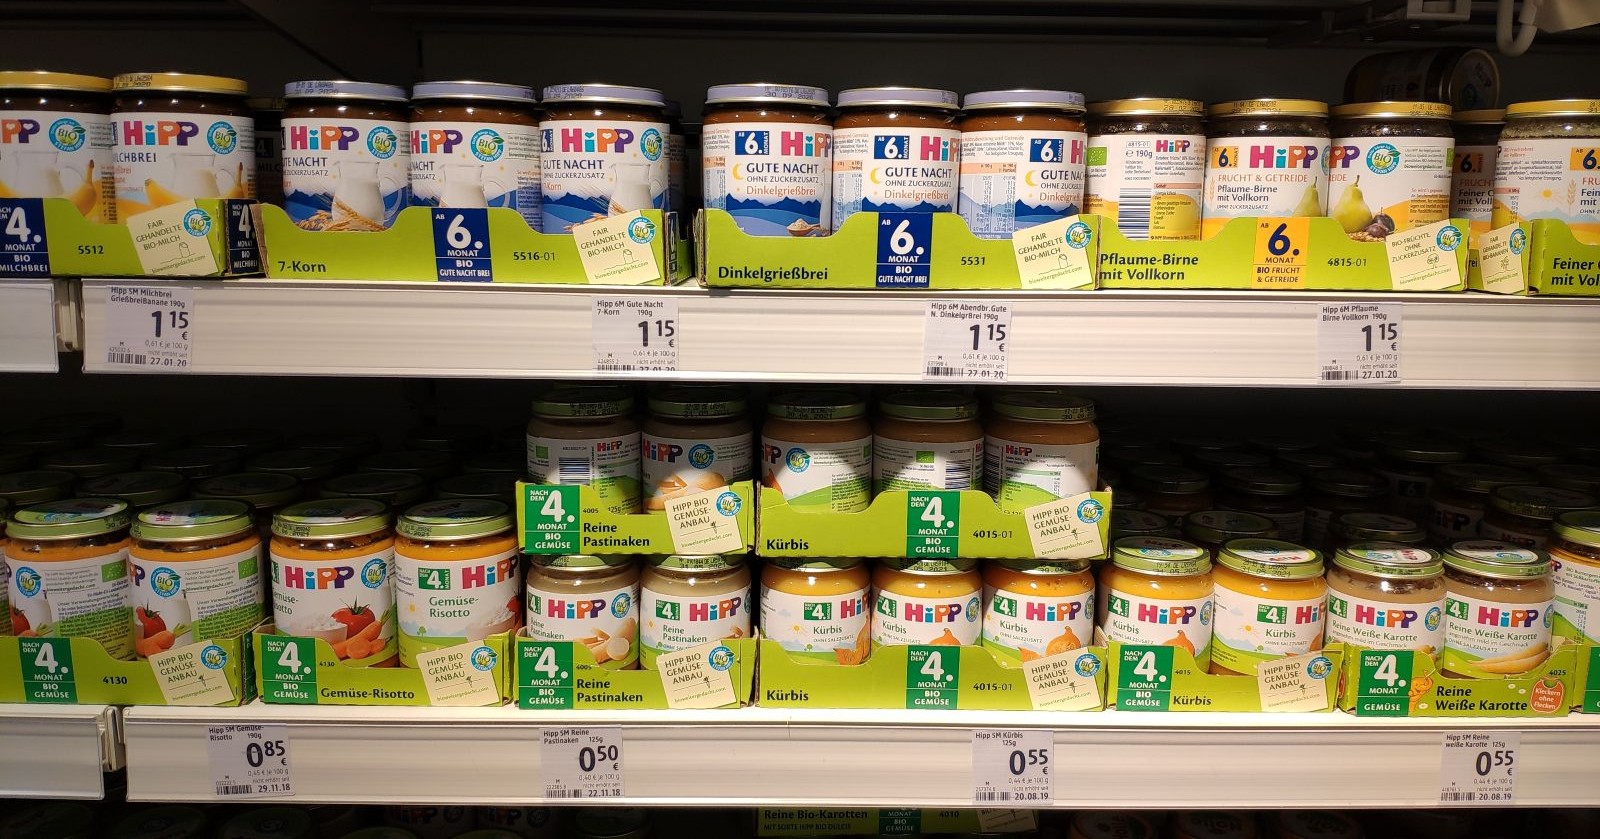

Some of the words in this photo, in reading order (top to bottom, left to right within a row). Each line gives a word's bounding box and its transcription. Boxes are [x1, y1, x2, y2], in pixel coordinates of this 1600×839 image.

[291, 126, 359, 150] HiPP
[561, 128, 634, 153] HiPP
[1156, 140, 1190, 153] HiPP
[1249, 145, 1318, 169] HiPP
[746, 163, 779, 173] GUTE
[783, 164, 819, 173] NACHT
[1265, 174, 1308, 183] GETREIDE
[746, 186, 816, 197] Dinkelgrießbrei
[5, 207, 41, 243] 4.
[446, 214, 484, 250] 6.
[592, 228, 608, 236] FAIR
[890, 219, 924, 255] 6.
[580, 232, 626, 250] GEHANDELTE
[1268, 224, 1300, 256] 6.
[1392, 232, 1431, 247] BIO-FRÜCHTE
[78, 245, 104, 255] 5512
[587, 242, 625, 258] BIO-MILCH
[1404, 242, 1422, 251] OHNE
[14, 255, 31, 263] BIO
[447, 249, 479, 258] MONAT
[513, 252, 555, 261] 5516-01
[1392, 245, 1436, 263] ZUCKERZUSATZ
[961, 256, 985, 265] 5531
[1100, 254, 1198, 265] Pflaume-Birne
[1327, 258, 1366, 267] 4815-01
[1553, 258, 1594, 270] Feiner
[278, 260, 326, 272] 7-Korn
[1271, 267, 1300, 275] FRUCHT
[718, 267, 828, 281] Dinkelgrießbrei
[878, 275, 894, 284] GUTE
[894, 276, 914, 284] NACHT
[915, 276, 927, 284] BREI
[1100, 269, 1122, 280] mit
[1127, 269, 1185, 280] Vollkorn
[1264, 276, 1299, 284] GETREIDE
[1551, 275, 1575, 286] mit
[141, 289, 172, 297] Milchbrei
[111, 296, 168, 306] GrießbreiBanane
[598, 300, 613, 308] Hipp
[150, 358, 186, 366] 27.01.20
[1363, 370, 1397, 379] 27.01.20
[540, 490, 575, 523] 4.
[693, 498, 709, 507] BIO
[674, 507, 711, 521] GEMÜSE-
[583, 522, 617, 533] Reine
[679, 516, 710, 529] ANBAU
[973, 530, 1012, 539] 4015-01
[535, 540, 571, 549] GEMÜSE
[583, 536, 650, 547] Pastinaken
[767, 539, 809, 550] Kürbis
[284, 565, 354, 590] HiPP
[429, 596, 478, 606] Gemüse-
[429, 608, 470, 618] Risotto
[905, 603, 961, 623] HiPP
[1026, 601, 1081, 621] HiPP
[1478, 606, 1538, 628] HiPP
[1449, 622, 1472, 635] Reine
[1475, 627, 1505, 639] Weiße
[1506, 631, 1537, 641] Karotte
[103, 676, 127, 685] 4130
[321, 687, 414, 699] Gemüse-Risotto
[1437, 686, 1471, 697] Reine
[1535, 688, 1560, 696] Kleckern
[1173, 695, 1211, 706] Kürbis
[1436, 699, 1473, 711] Weiße
[1479, 699, 1527, 711] Karotte
[258, 783, 290, 793] 29.11.18
[589, 789, 620, 797] 22.11.18
[765, 809, 795, 819] Reine
[798, 809, 867, 819] Bio-Karotten
